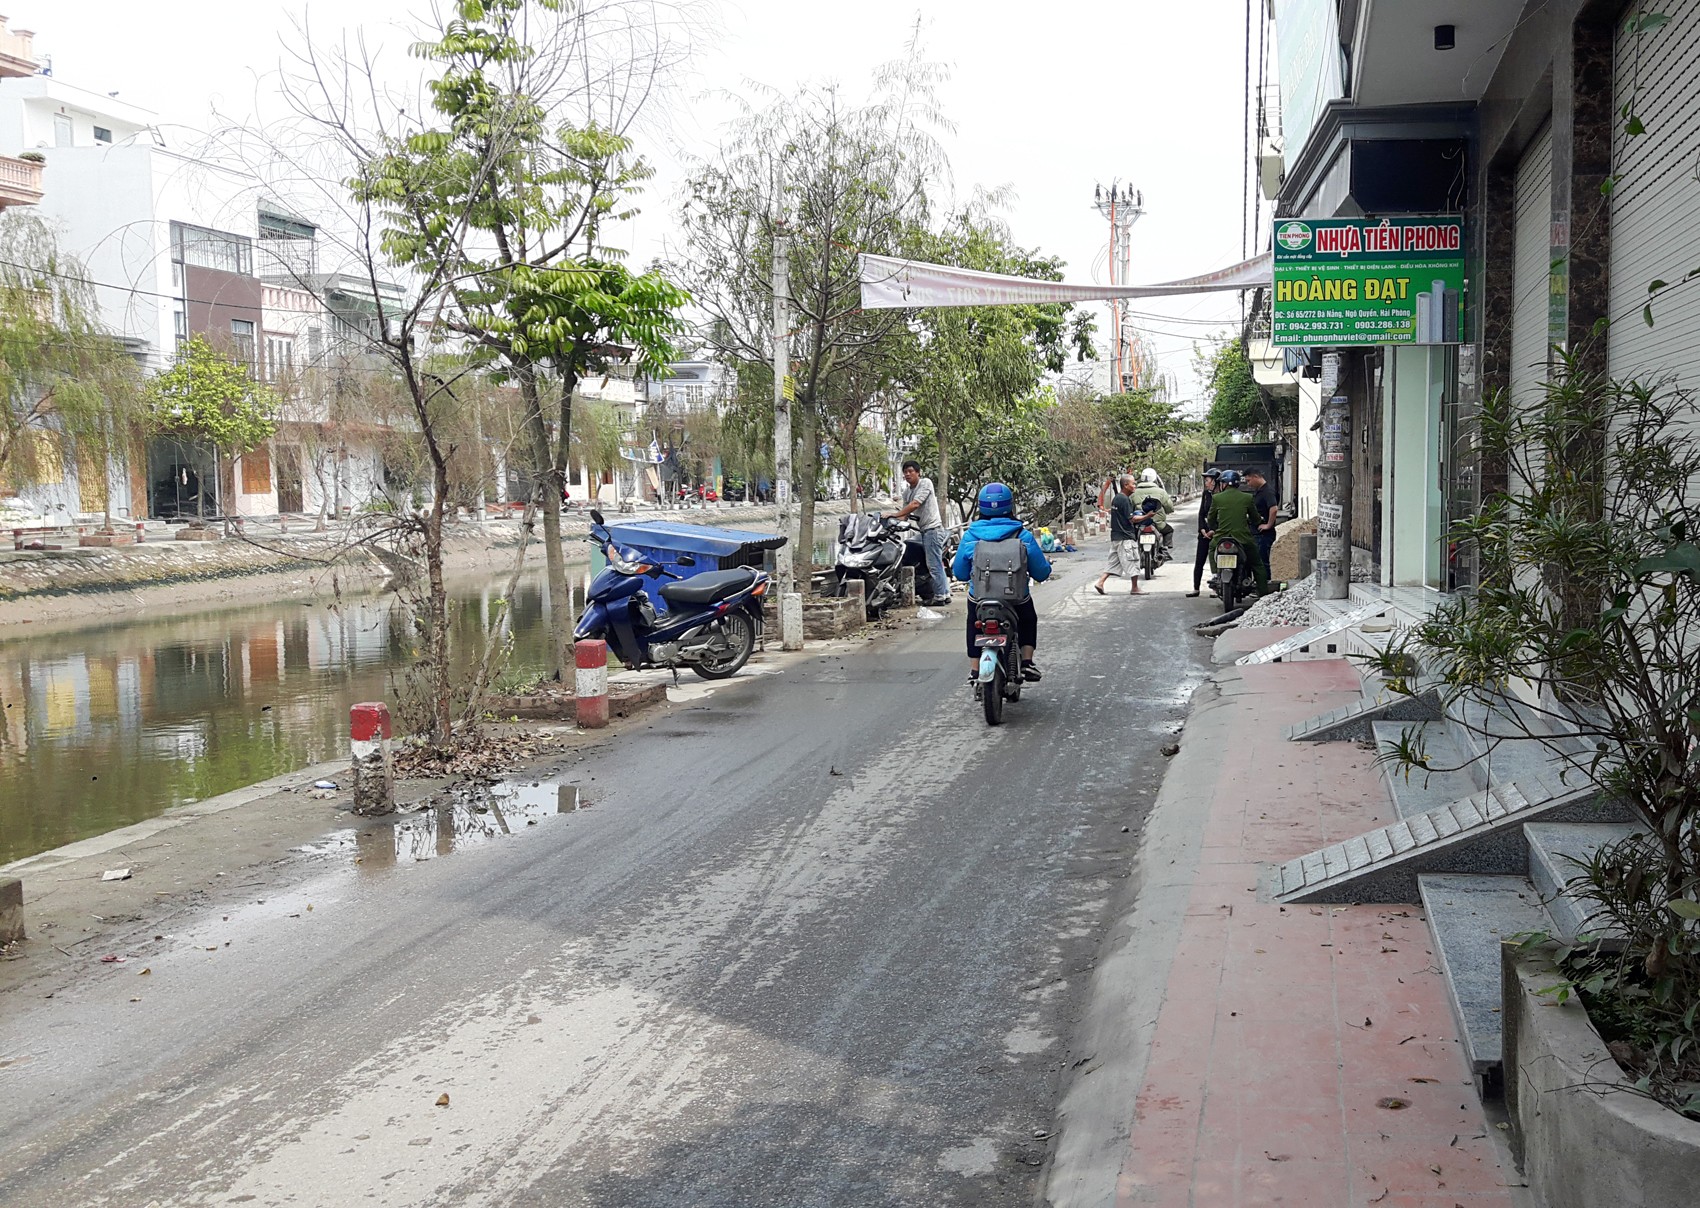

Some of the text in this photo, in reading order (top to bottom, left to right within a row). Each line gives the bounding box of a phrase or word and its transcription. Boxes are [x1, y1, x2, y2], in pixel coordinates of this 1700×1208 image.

[1316, 219, 1460, 257] NHỰA TIỀN PHONG
[1318, 264, 1326, 272] VỆ
[1277, 275, 1410, 304] HOÀNG ĐẠT
[1286, 309, 1295, 318] Số
[1345, 309, 1358, 319] Ngô
[1380, 308, 1391, 317] Hải
[1391, 308, 1411, 318] Phòng
[1275, 322, 1288, 331] ĐT:
[1289, 321, 1344, 331] 0942.993.731
[1354, 320, 1411, 330] 0903.286.138
[1275, 332, 1411, 344] Email: phungnhuviet@gmail.com
